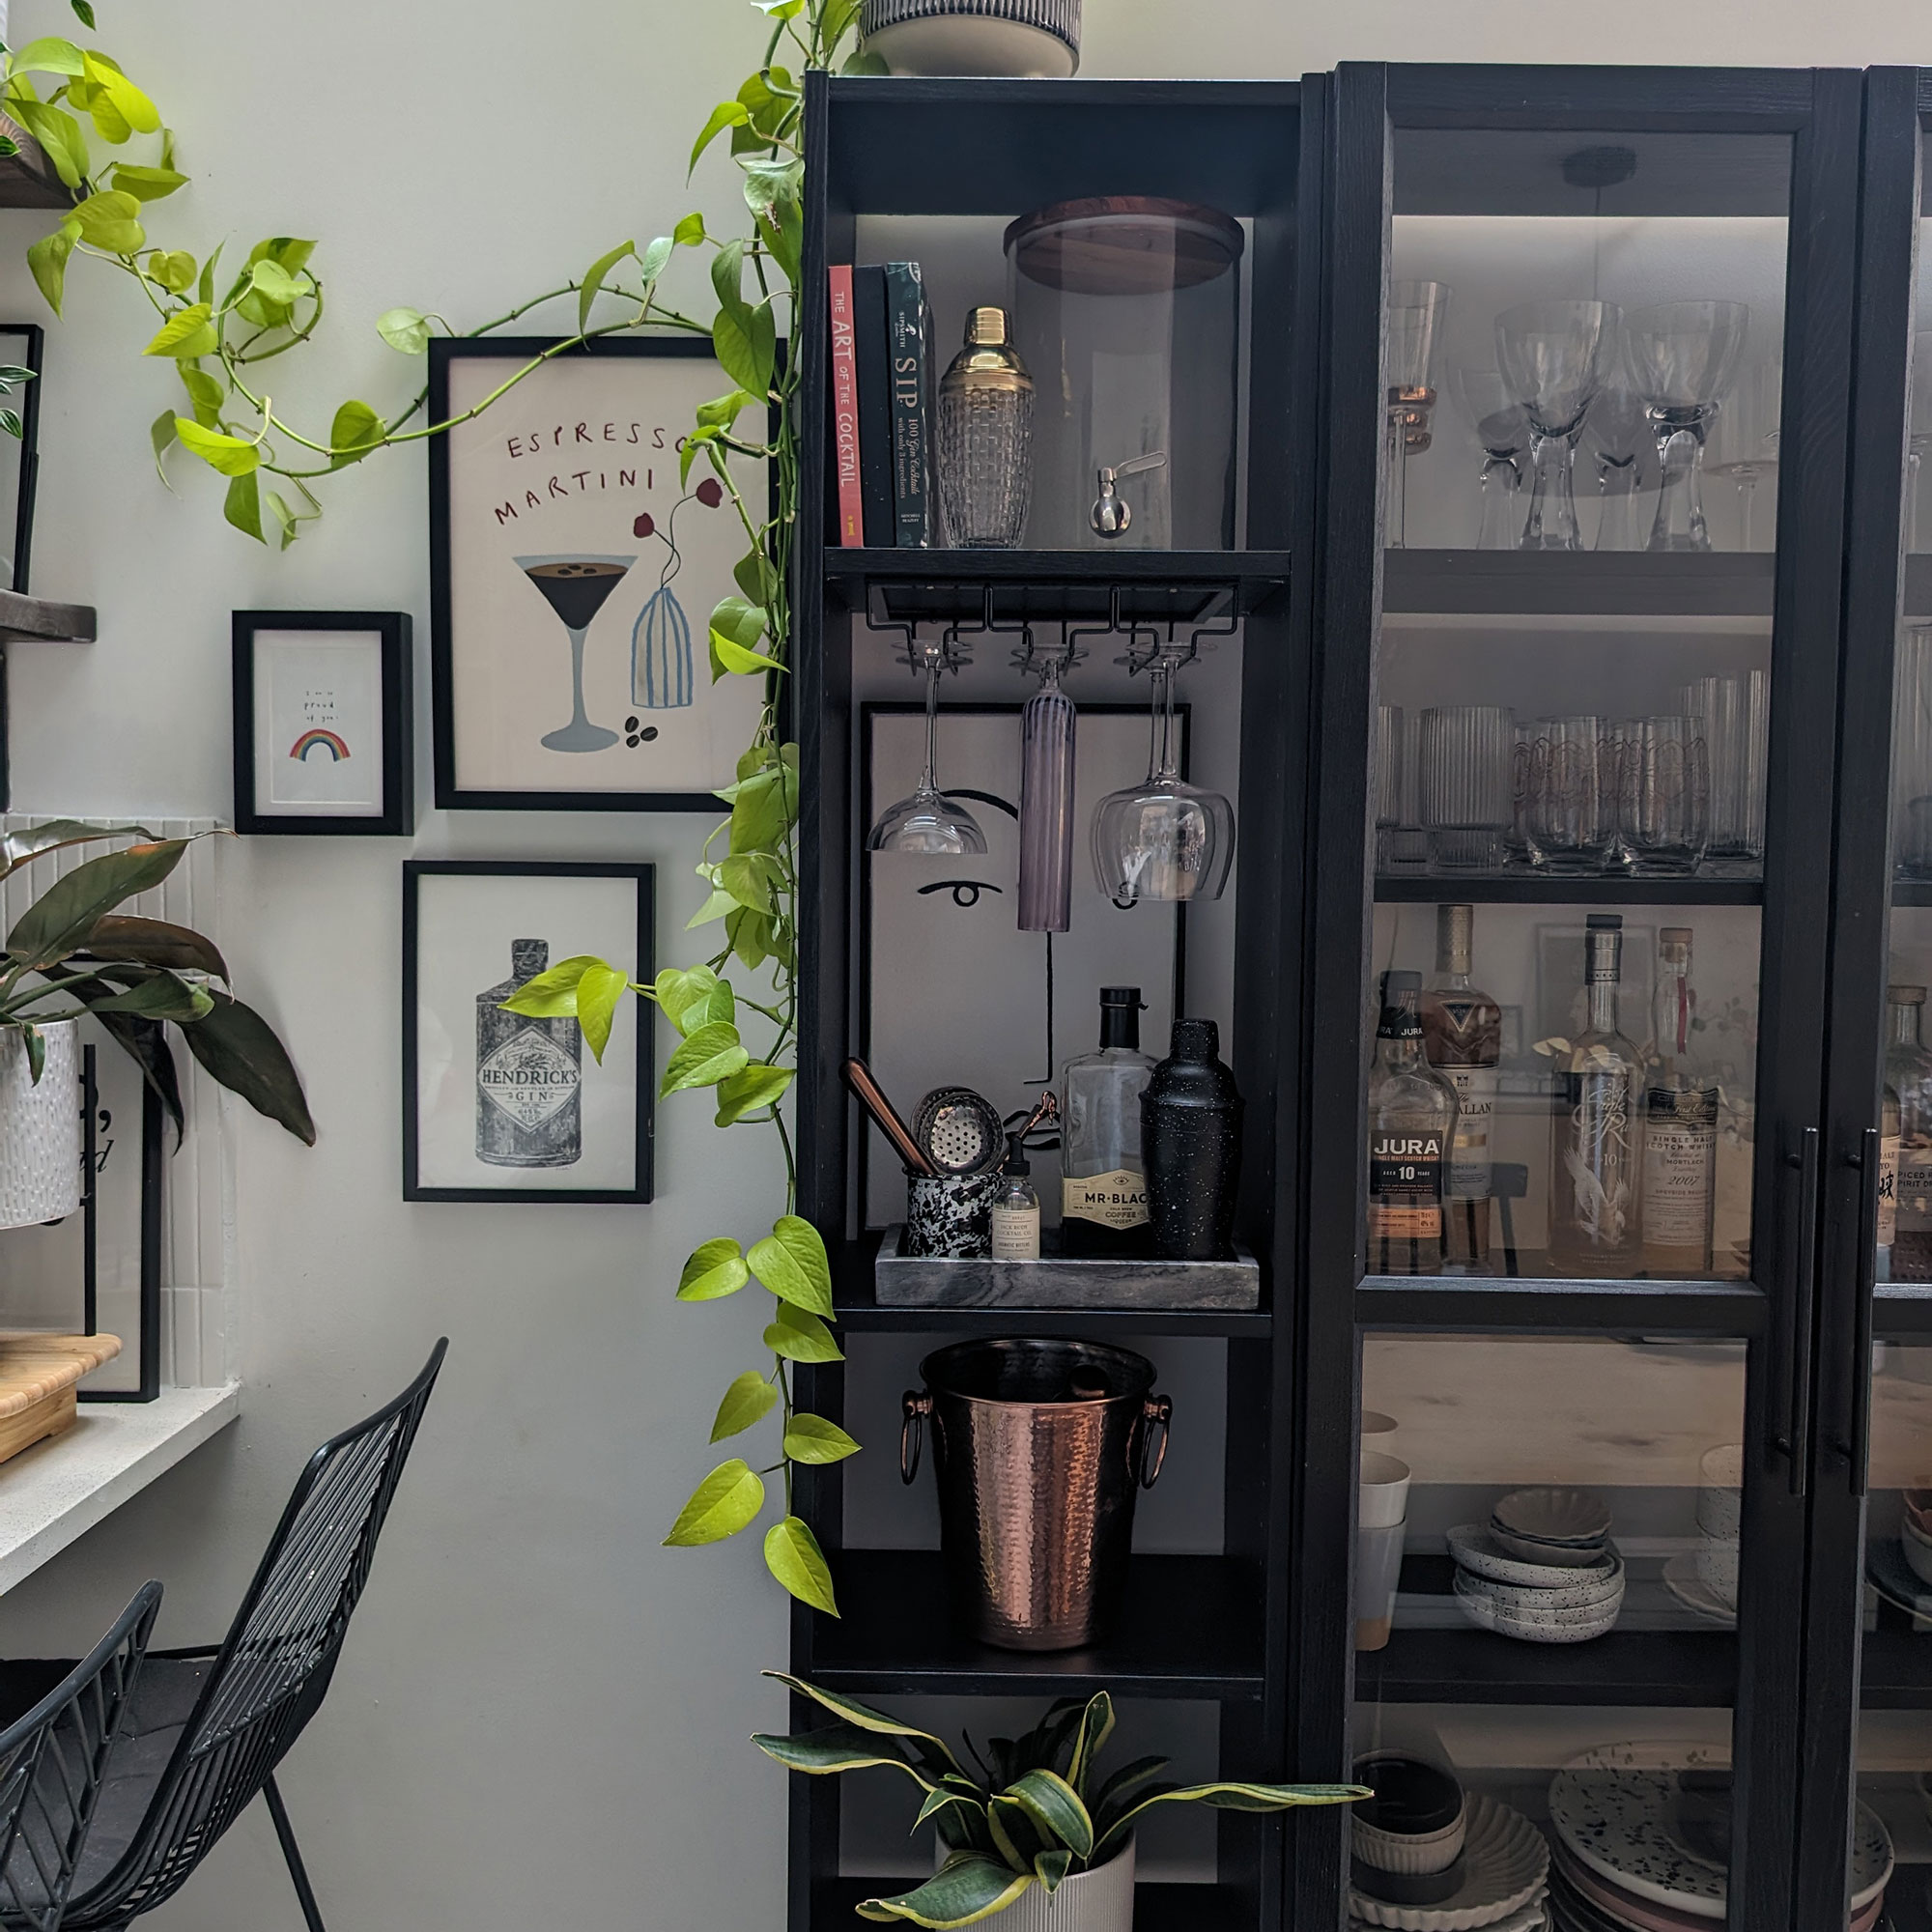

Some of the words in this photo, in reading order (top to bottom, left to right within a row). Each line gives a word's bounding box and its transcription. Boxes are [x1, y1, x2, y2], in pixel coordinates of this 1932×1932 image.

[834, 291, 845, 313] THE
[833, 320, 852, 360] ART
[838, 365, 850, 382] OF
[838, 384, 850, 405] THE
[908, 417, 919, 438] 100
[838, 412, 856, 488] COCKTAIL
[897, 435, 906, 452] only
[905, 439, 920, 457] Gin
[897, 459, 907, 499] ingredients
[909, 457, 921, 496] Cocktails
[494, 469, 654, 526] MARTINI
[1401, 1027, 1423, 1036] JURA
[482, 1068, 578, 1085] HENDRICK'S
[515, 1092, 548, 1101] GIN
[1459, 1102, 1492, 1115] ALLAN
[1374, 1138, 1439, 1154] JURA
[1646, 1142, 1684, 1151] SCOTCH
[1604, 1153, 1617, 1166] 10
[1880, 1151, 1895, 1159] ALT
[1398, 1166, 1415, 1179] 10
[1667, 1175, 1701, 1186] 2007
[1898, 1171, 1925, 1179] PICED
